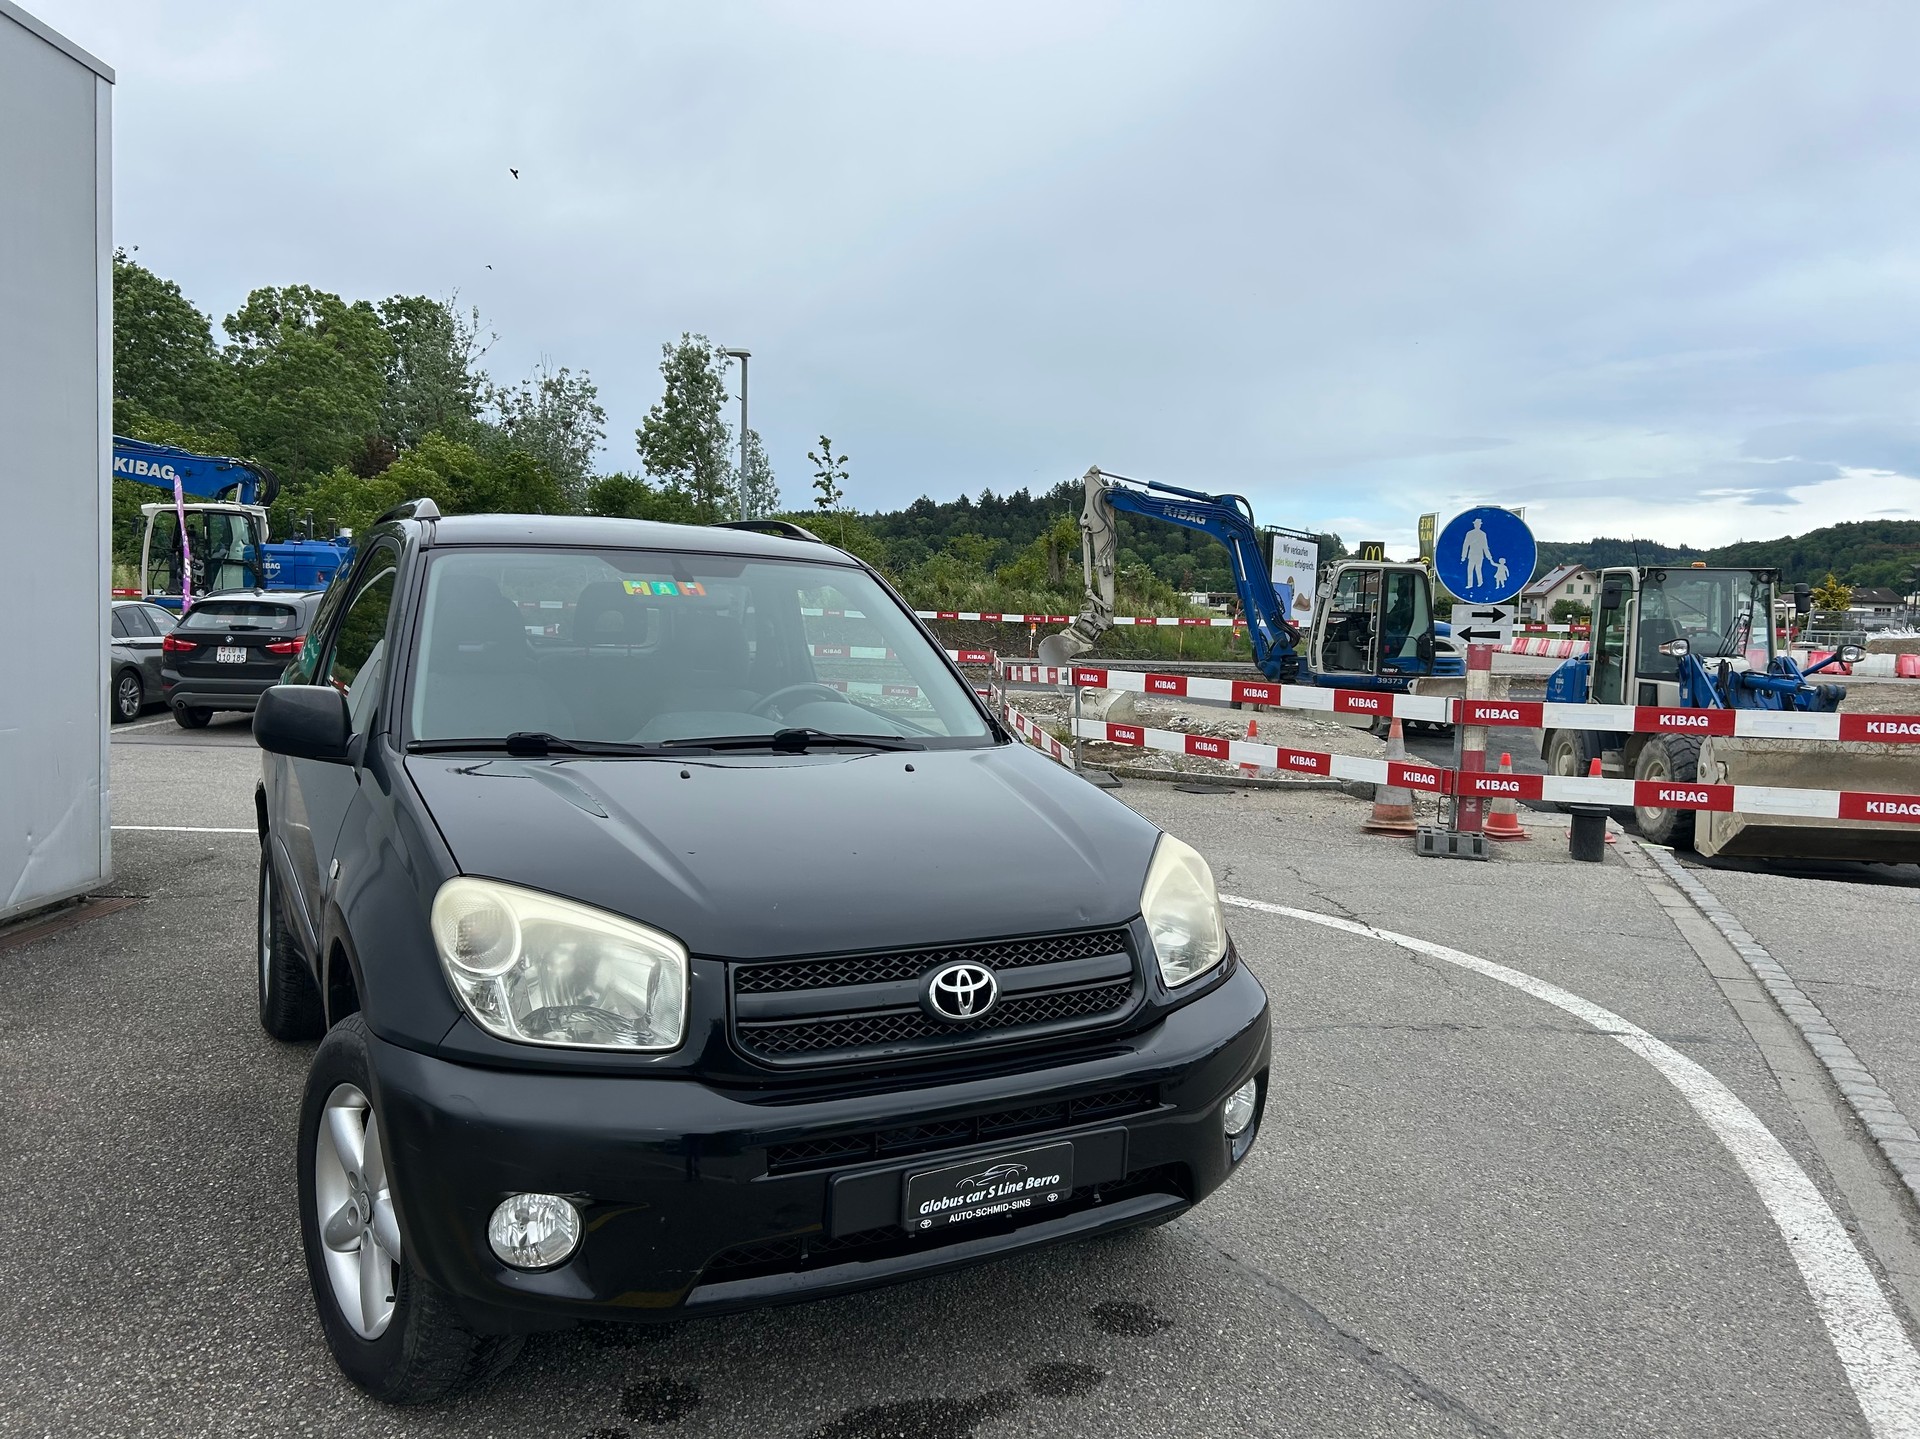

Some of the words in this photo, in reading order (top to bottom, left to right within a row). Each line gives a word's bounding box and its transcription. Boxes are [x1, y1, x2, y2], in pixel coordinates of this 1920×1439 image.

[113, 456, 175, 480] KIBAG
[1162, 504, 1207, 525] KIBAG
[1079, 673, 1099, 683] KIBAG
[1377, 677, 1403, 685] 39373
[1154, 680, 1177, 690] KIBAG
[1242, 687, 1269, 699] KIBAG
[1348, 697, 1379, 709] KIBAG
[1475, 708, 1520, 720] KIBAG
[1659, 714, 1709, 727] KIBAG
[1115, 729, 1135, 740] KIBAG
[1866, 721, 1920, 735] KIBAG
[1195, 742, 1218, 753] KIBAG
[1289, 755, 1317, 768] KIBAG
[1402, 770, 1436, 786] KIBAG
[1475, 779, 1520, 792] KIBAG
[1659, 789, 1709, 803] KIBAG
[1866, 801, 1920, 816] KIBAG
[919, 1196, 964, 1214] Globus
[965, 1190, 987, 1203] car
[987, 1185, 997, 1199] S
[997, 1181, 1024, 1196] Line
[1025, 1174, 1060, 1190] Berro
[948, 1198, 1031, 1223] AUTO-SCHMID-SINS
